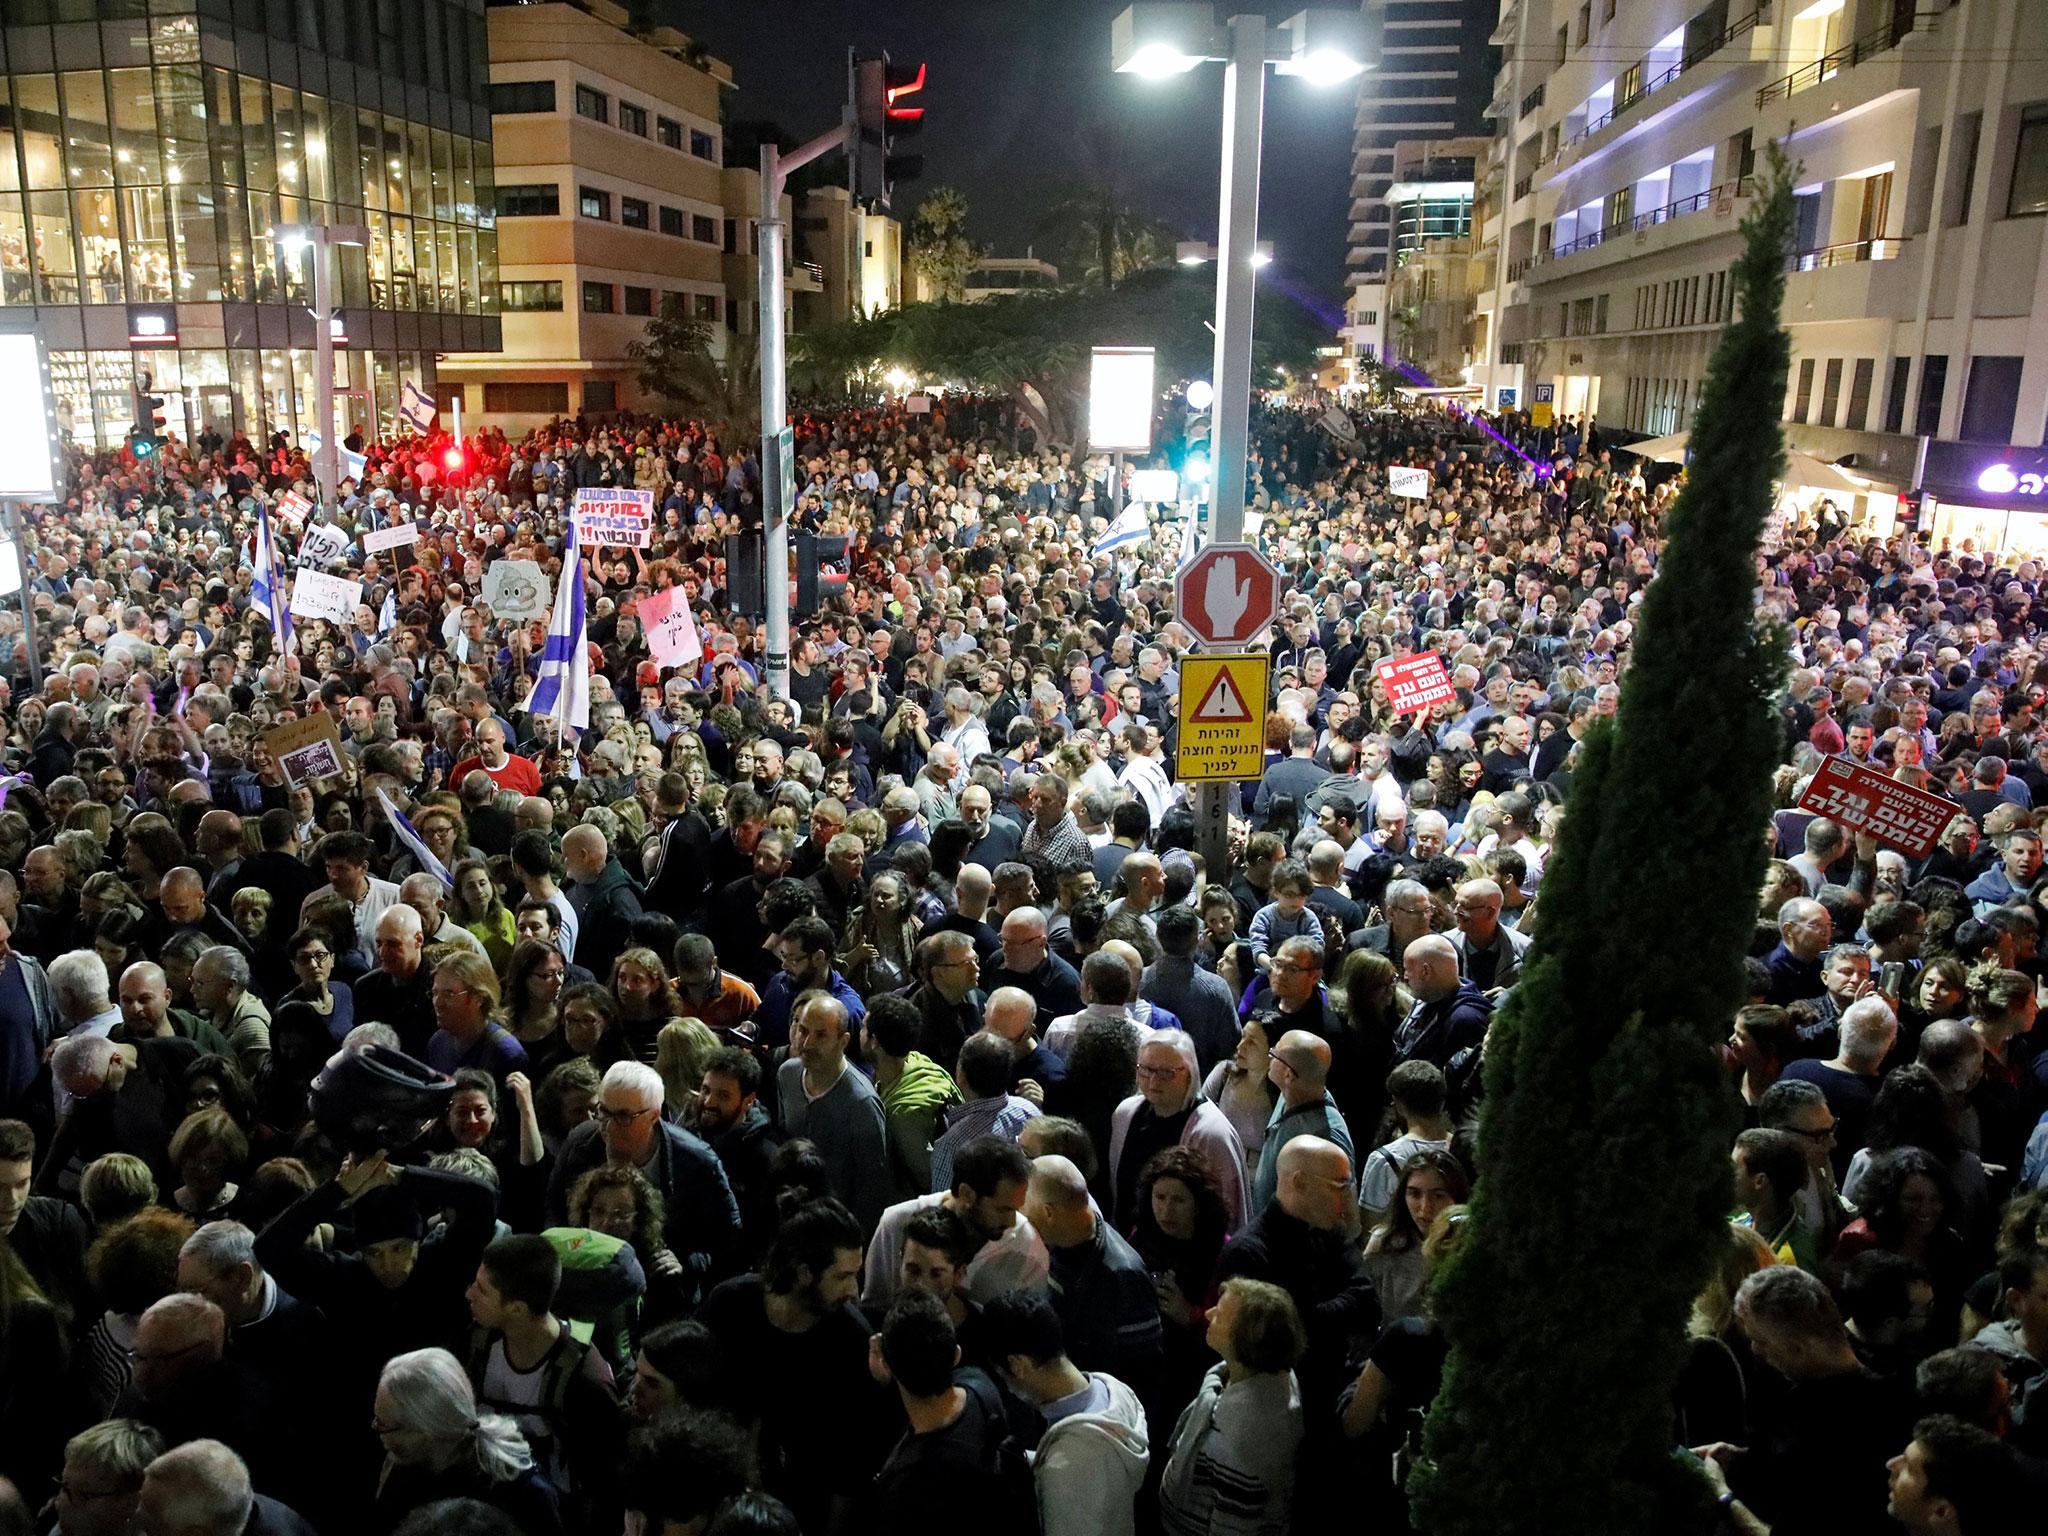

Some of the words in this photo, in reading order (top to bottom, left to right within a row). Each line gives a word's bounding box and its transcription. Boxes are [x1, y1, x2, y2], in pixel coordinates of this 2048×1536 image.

[578, 502, 646, 518] בחקירות
[1392, 680, 1417, 697] נגד
[1416, 671, 1447, 690] העם
[1393, 683, 1452, 711] הממשלה
[1198, 728, 1240, 740] זהירות
[1182, 745, 1214, 756] חוצה
[1219, 744, 1259, 756] תנועה
[1202, 759, 1237, 774] לפניך
[1827, 784, 1871, 811] נגד
[1858, 776, 1948, 817] כשהממשלה
[1881, 796, 1914, 814] העם
[1806, 793, 1928, 852] הממשלה
[1874, 806, 1936, 838] העם
[1917, 808, 1942, 825] נגד
